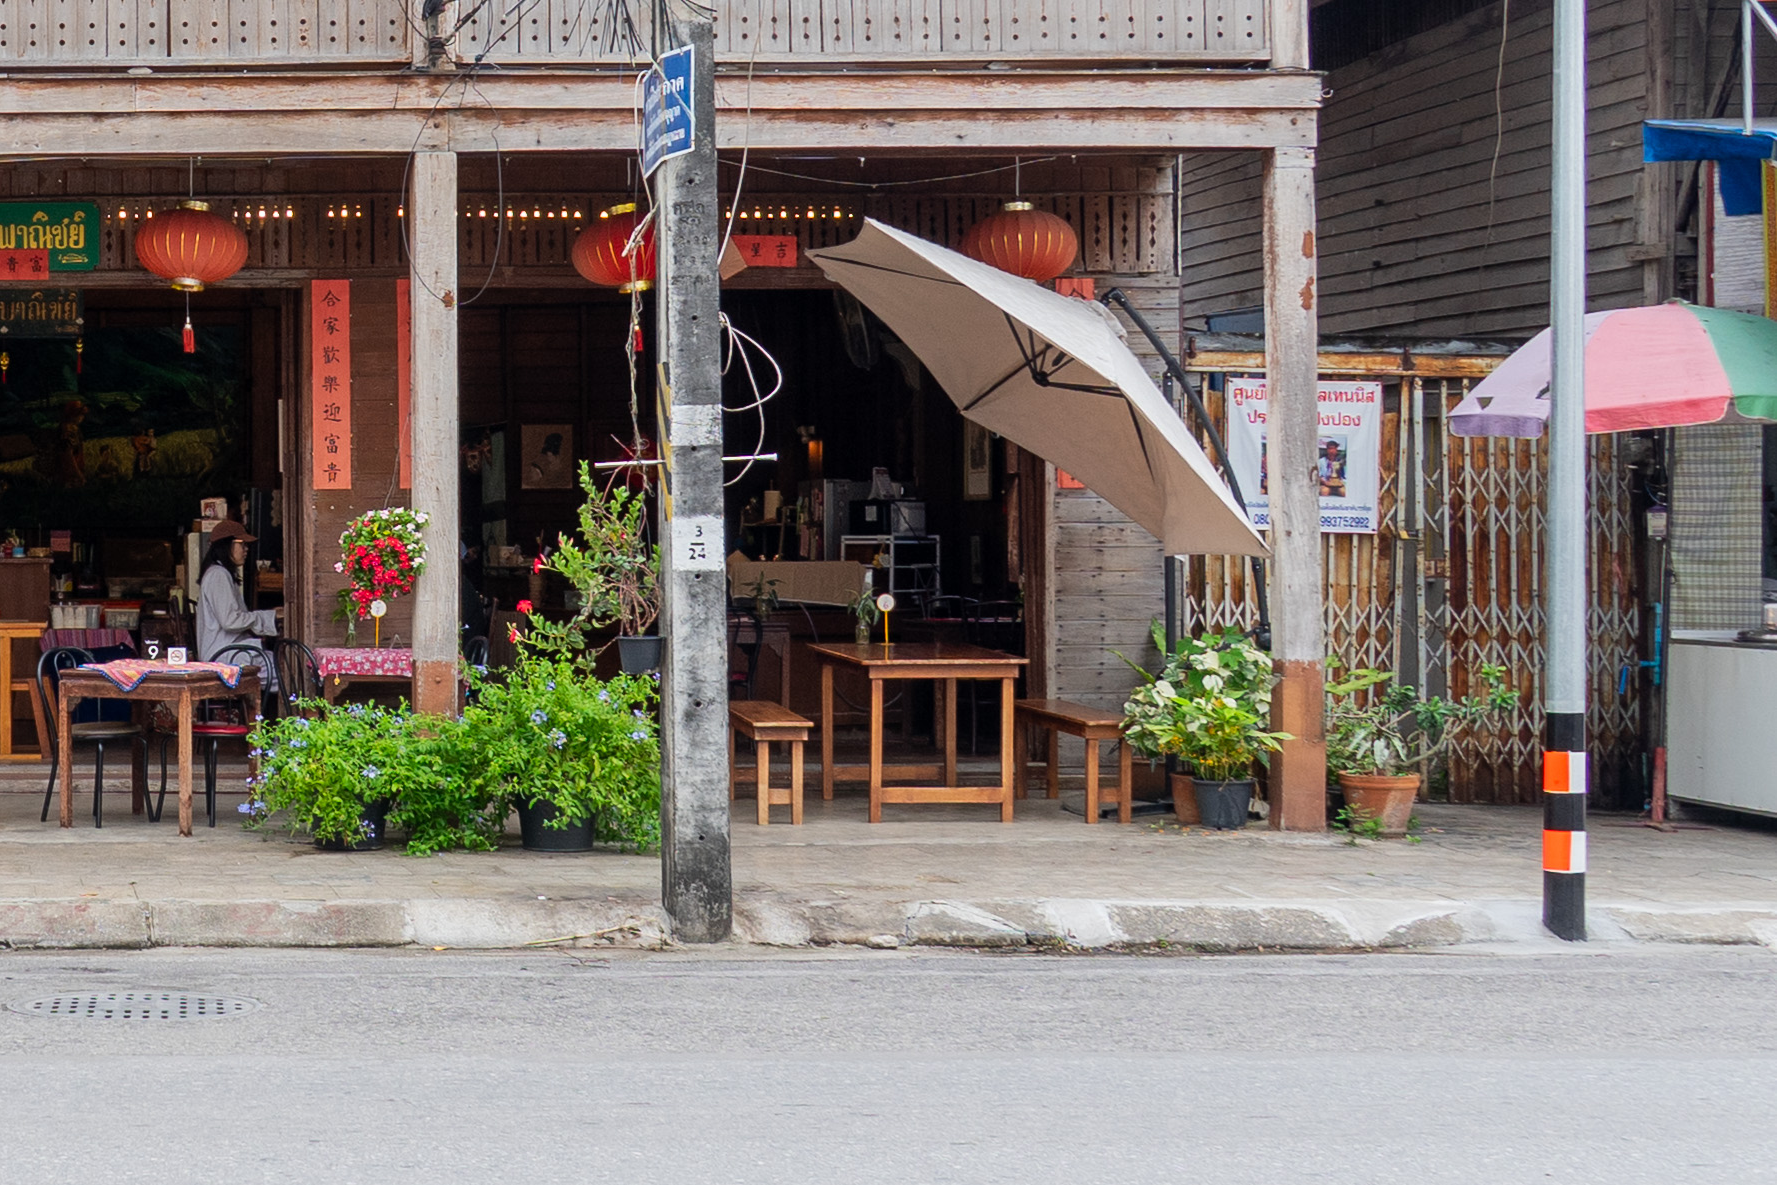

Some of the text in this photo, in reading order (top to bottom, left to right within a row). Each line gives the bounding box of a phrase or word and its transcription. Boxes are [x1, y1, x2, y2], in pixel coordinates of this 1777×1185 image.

[695, 525, 703, 537] 3
[688, 547, 706, 560] 24
[148, 645, 159, 659] 9
